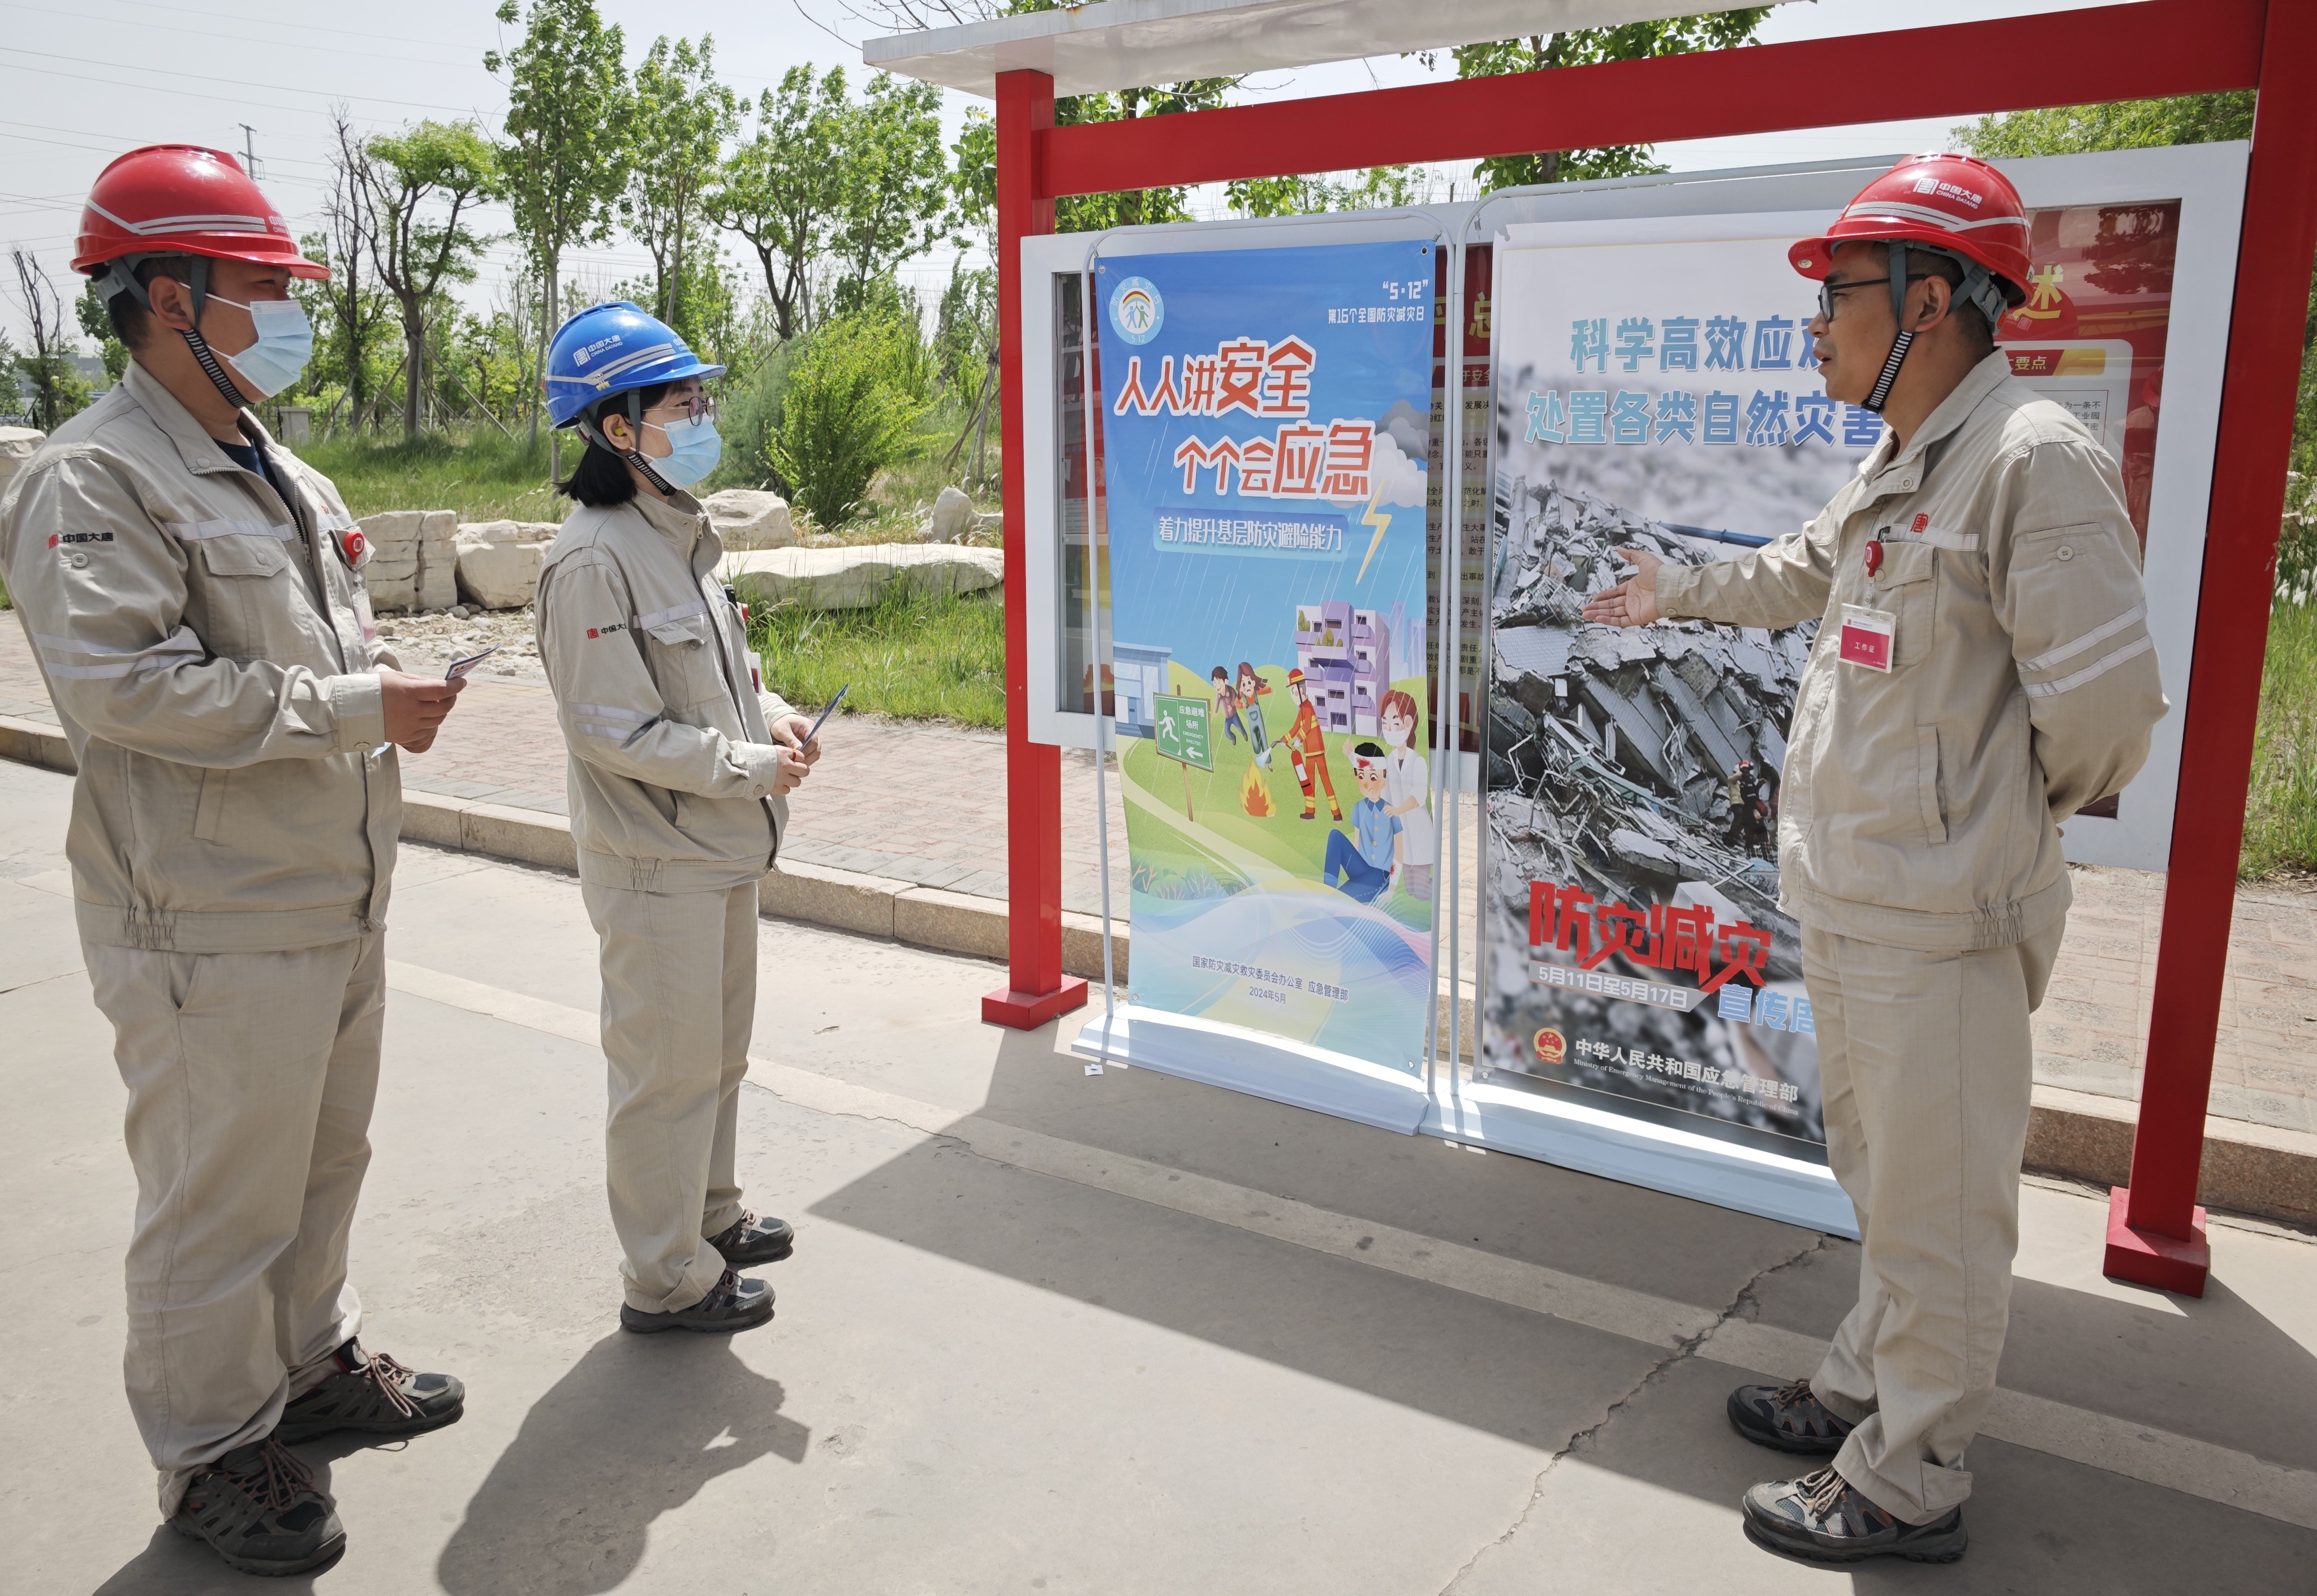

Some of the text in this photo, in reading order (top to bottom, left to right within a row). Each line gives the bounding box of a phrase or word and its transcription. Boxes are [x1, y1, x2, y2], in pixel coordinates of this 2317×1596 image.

[1936, 190, 1978, 209] CHINA DATANG
[1328, 306, 1424, 325] 第16个全国防灾减灾日
[591, 341, 623, 357] CHINA DATANG
[1116, 338, 1315, 415] 人人讲安全
[1524, 388, 1884, 446] 处置各类自然灾害
[1175, 422, 1374, 498] 个个会应急
[63, 532, 114, 543] 中国大唐
[1159, 516, 1342, 552] 着力提升基层防灾避险能力
[601, 623, 628, 634] 中国大
[1854, 641, 1875, 653] 工作证
[1186, 719, 1199, 730] 场所
[1529, 880, 1772, 994] 防灾减灾
[1192, 956, 1349, 1001] 国家防灾减灾救灾委员会办公室 应急管理部
[1249, 986, 1286, 1004] 2024年5月
[1539, 966, 1687, 1010] 5月11日至5月17日
[1574, 1058, 1600, 1071] Ministry
[1609, 1066, 1643, 1080] Emergency
[1646, 1075, 1686, 1089] Management
[1709, 1089, 1737, 1101] People's
[1738, 1095, 1768, 1108] Republic
[1778, 1105, 1799, 1116] China
[1575, 1038, 1799, 1103] 中华人民共和国应急管理部
